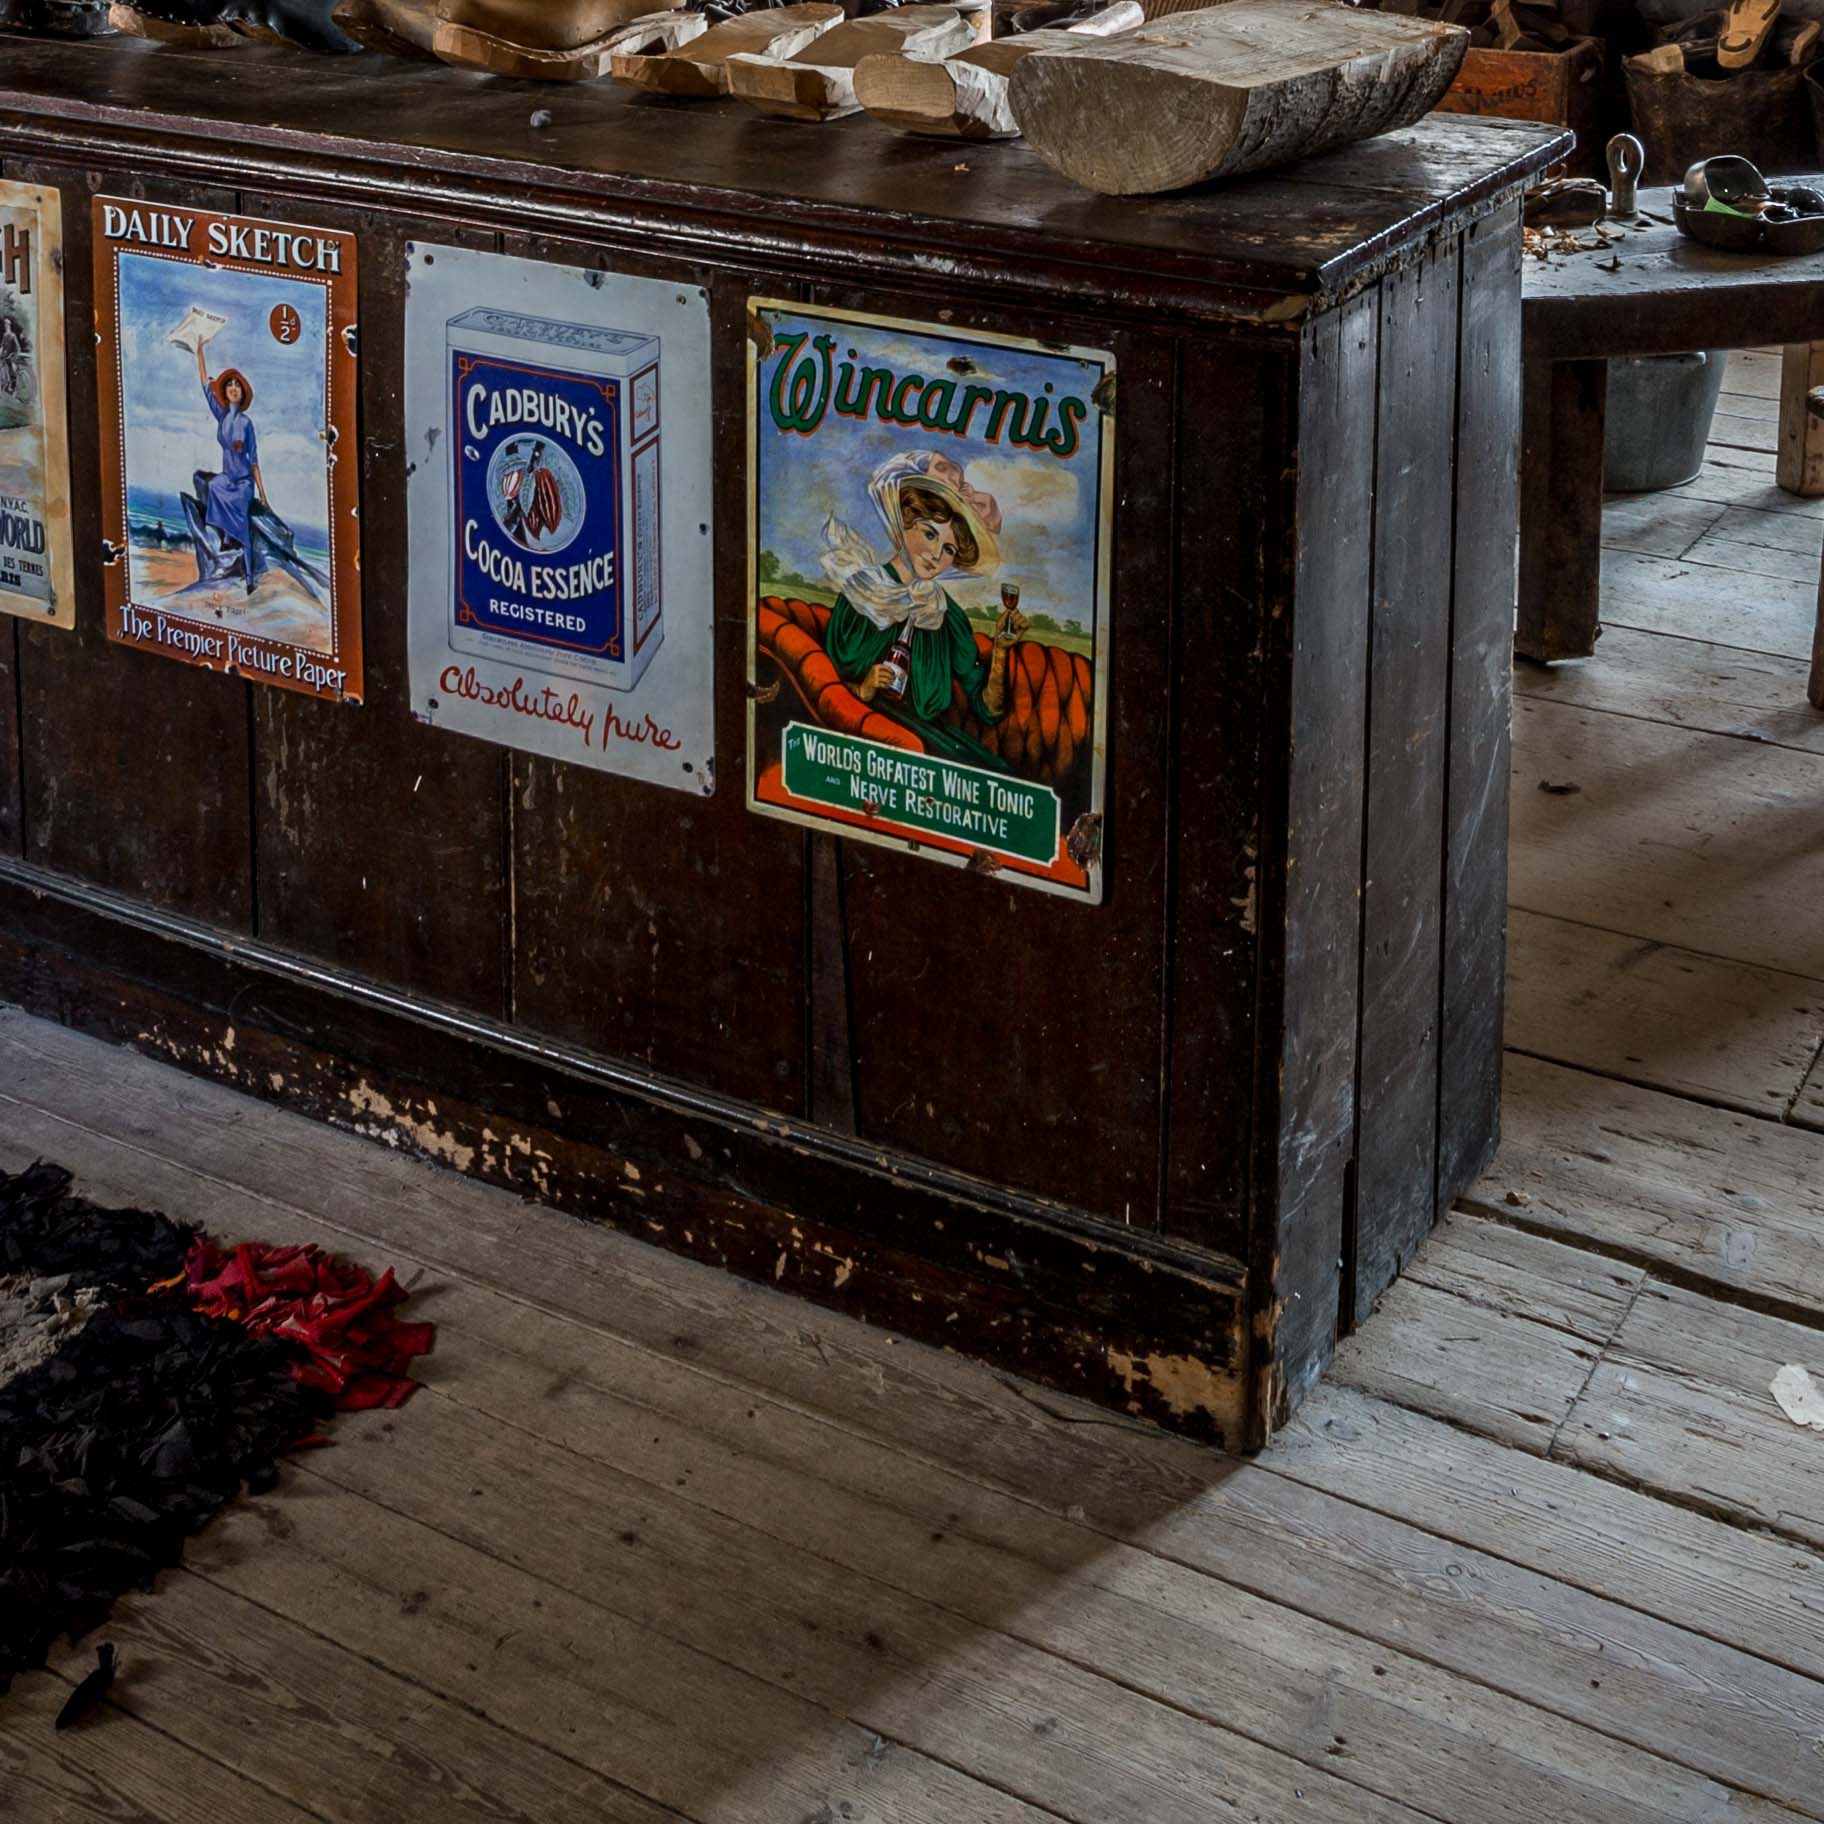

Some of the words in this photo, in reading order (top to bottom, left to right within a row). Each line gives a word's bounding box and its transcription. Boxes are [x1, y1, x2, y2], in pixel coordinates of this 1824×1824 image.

[102, 204, 196, 251] DAILY
[207, 222, 342, 275] SKETCH
[466, 383, 606, 457] CADBURY'S
[769, 331, 1087, 459] Wincarnis
[3, 555, 16, 570] DES
[464, 518, 527, 595] COCOA
[531, 550, 615, 601] ESSENCE
[119, 605, 154, 642] The
[156, 614, 225, 659] Premier
[227, 634, 293, 677] Picture
[295, 651, 347, 692] Paper
[488, 598, 587, 633] REGISTERED
[439, 666, 594, 747] Absolutely
[602, 702, 683, 752] pure
[802, 732, 862, 774] WORLD'S
[942, 767, 981, 805] WINE
[987, 779, 1035, 821] TONIC
[825, 775, 841, 786] AND
[849, 775, 898, 810] NERVE
[904, 788, 1009, 840] RESTORATIVE
